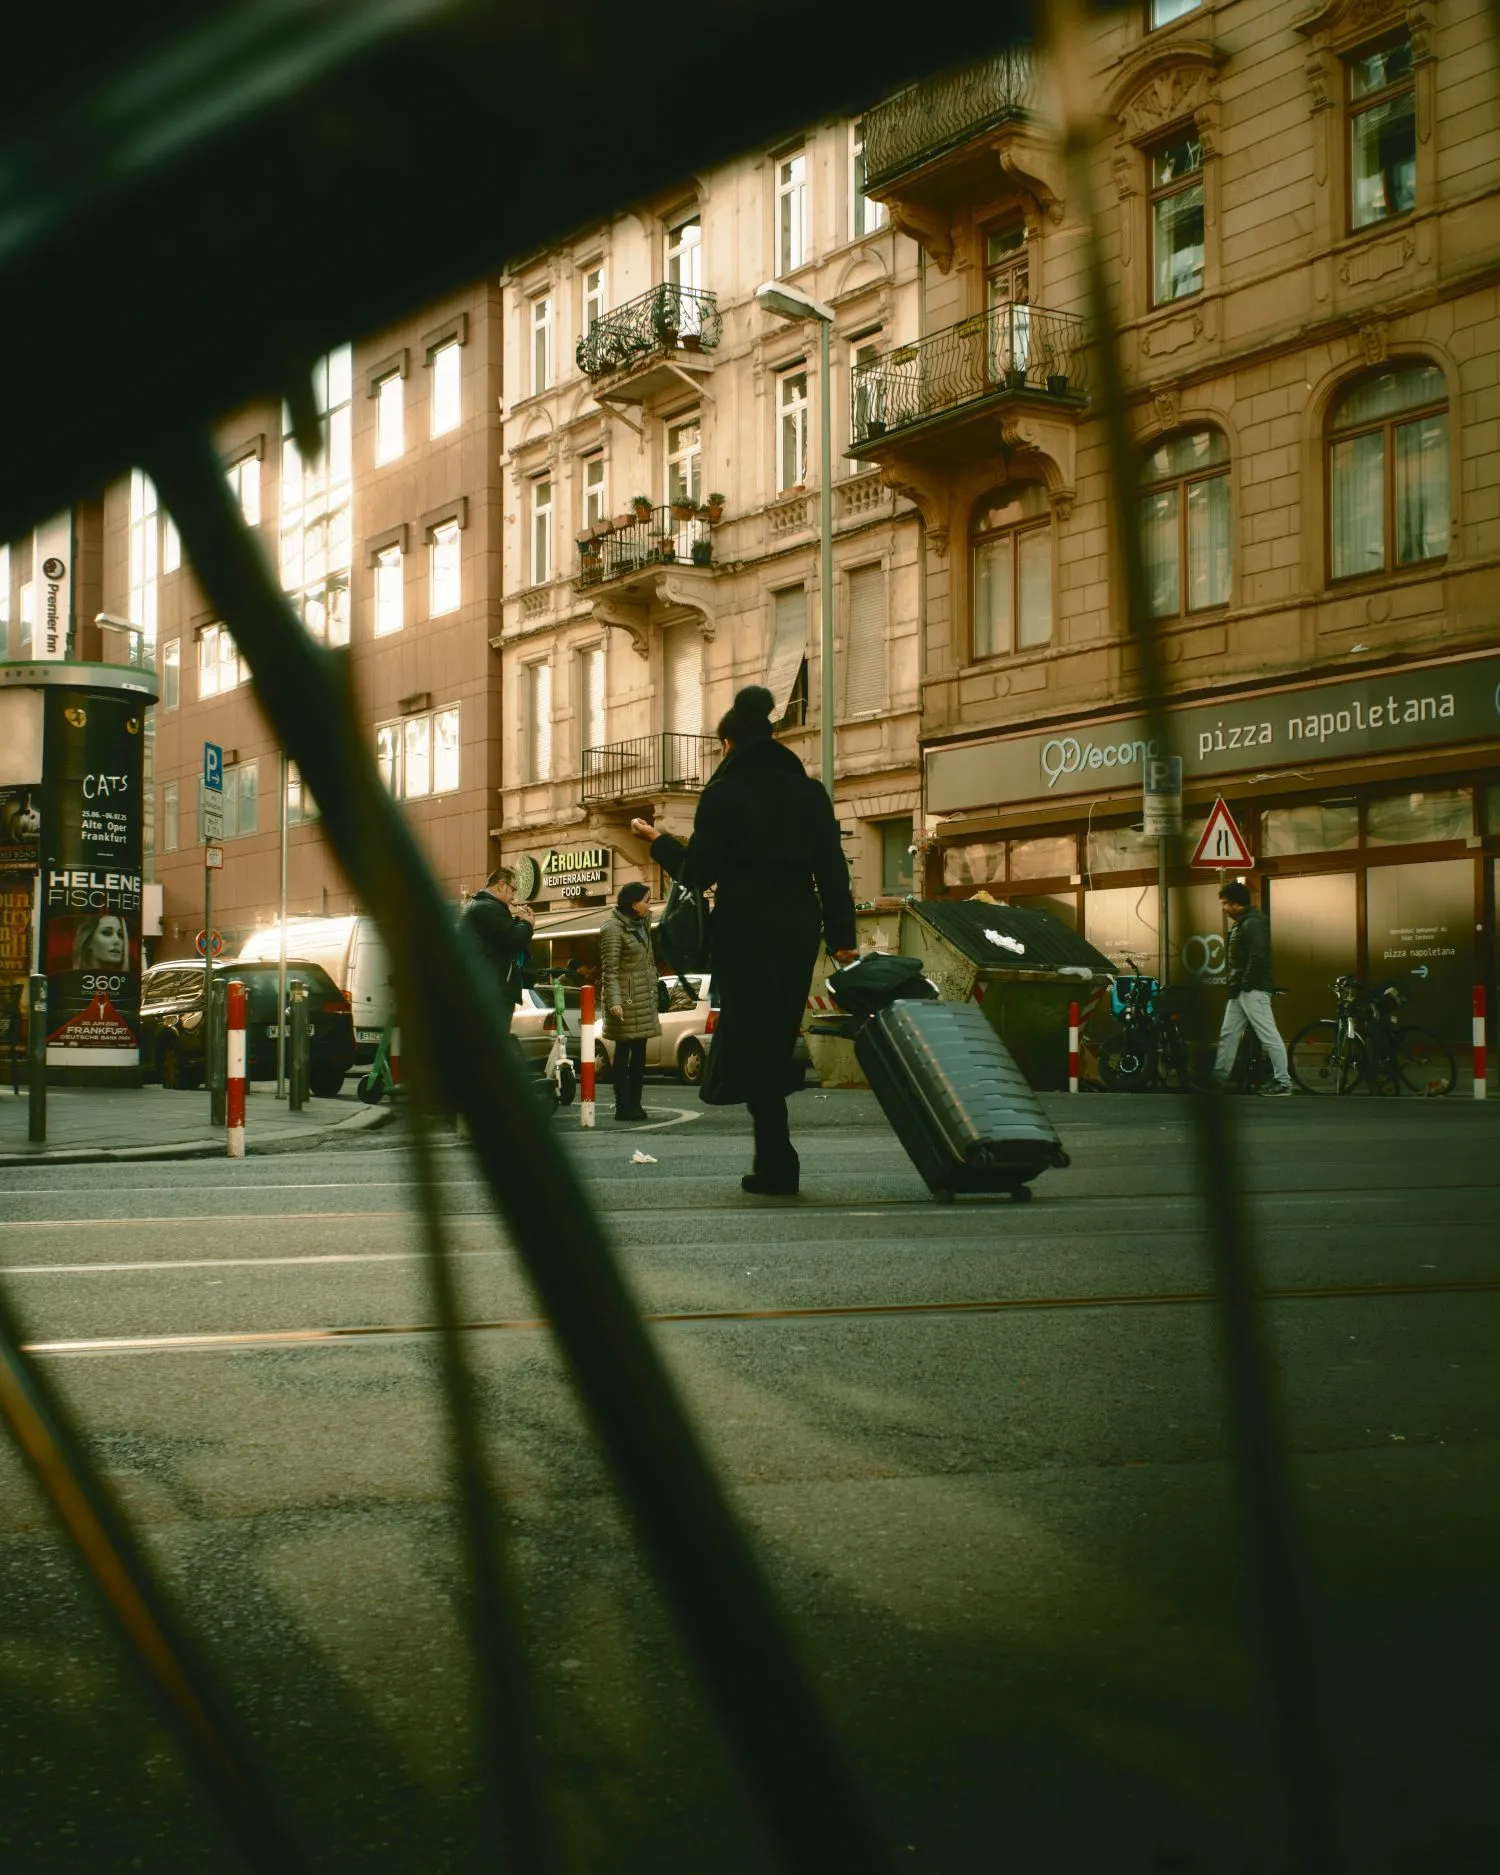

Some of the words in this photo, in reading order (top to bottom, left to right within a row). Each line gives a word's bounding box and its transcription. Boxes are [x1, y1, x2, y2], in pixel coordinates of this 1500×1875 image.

[47, 583, 59, 632] Premier
[47, 633, 59, 653] Inn
[1199, 722, 1273, 760] pizza
[1288, 693, 1455, 743] napoletana
[207, 748, 218, 782] P
[83, 774, 128, 799] CATS
[81, 820, 102, 830] Alte
[107, 822, 127, 833] Oper
[81, 831, 127, 843] Frankfurt
[49, 871, 140, 892] HELENE
[543, 871, 601, 887] MEDITERRANEAN
[48, 889, 140, 910] FISCHER
[561, 886, 581, 897] FOOD
[1384, 949, 1407, 960] pizza
[1410, 946, 1456, 958] napoletana
[67, 1026, 128, 1035] FRANKFURT
